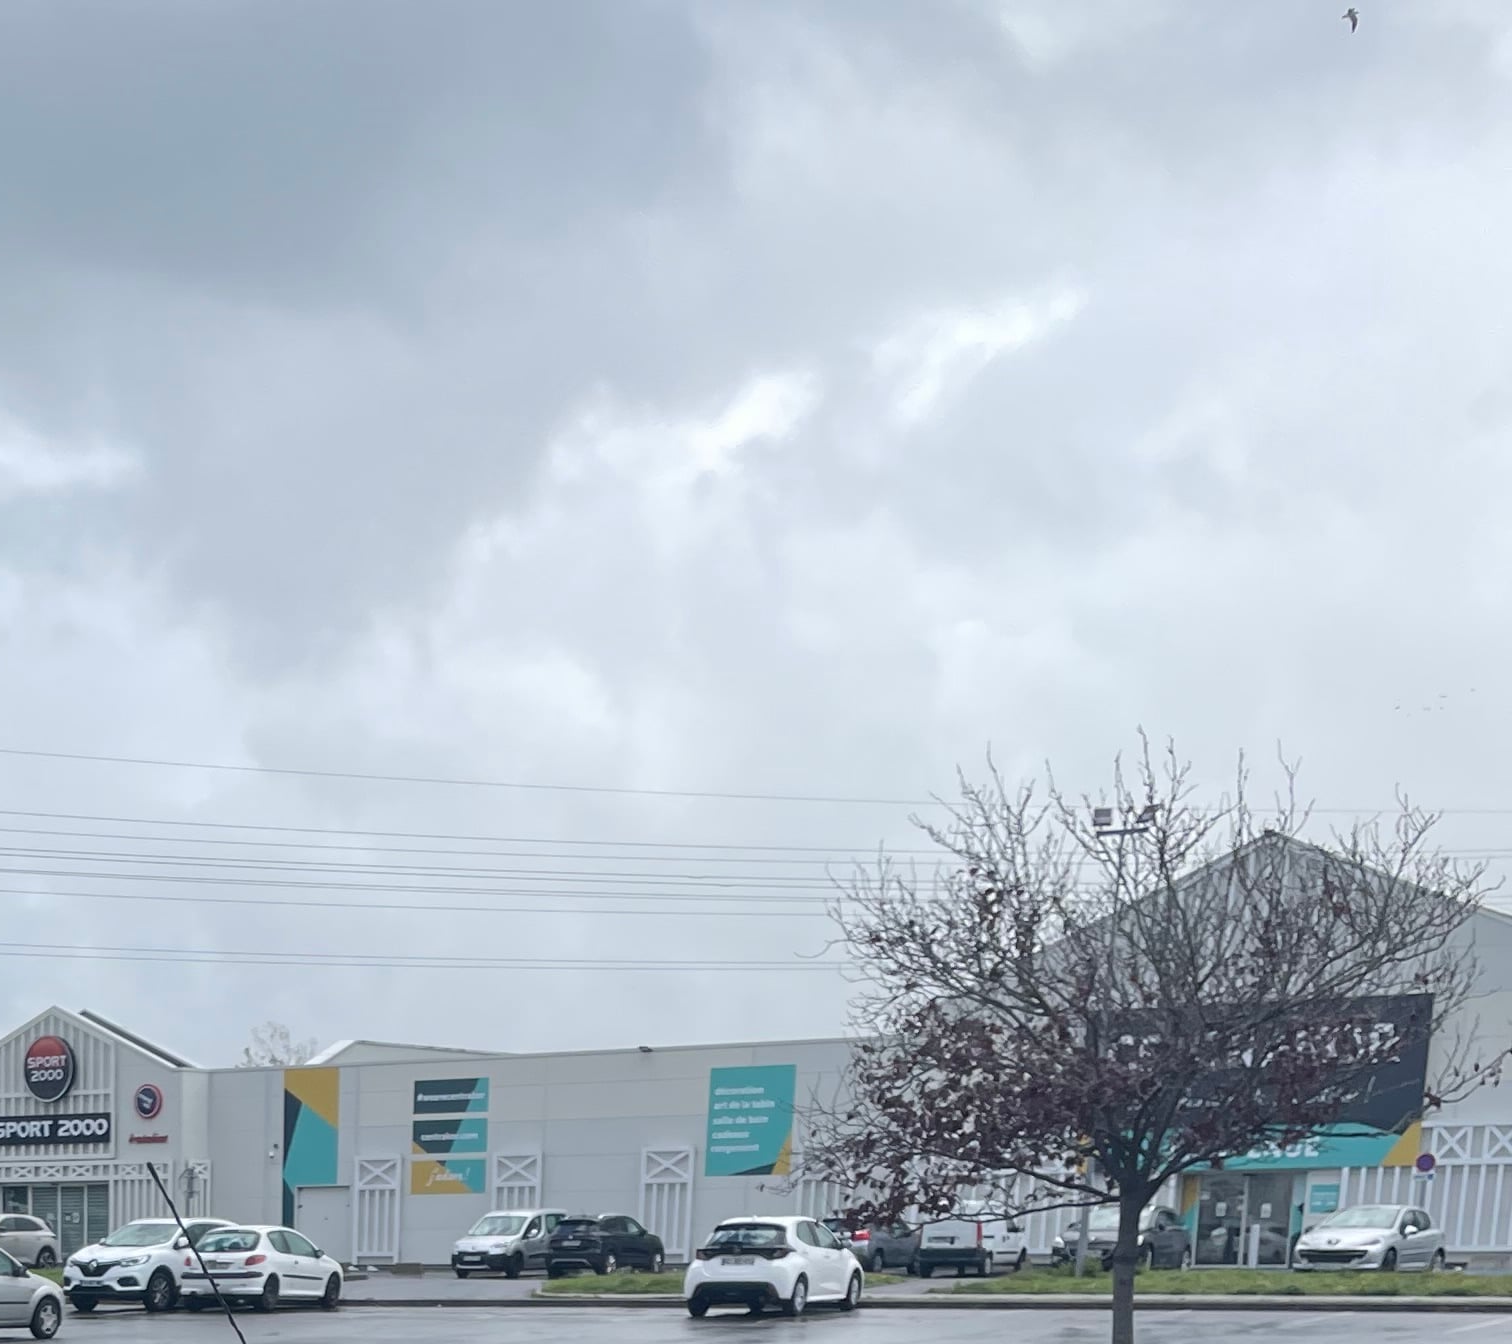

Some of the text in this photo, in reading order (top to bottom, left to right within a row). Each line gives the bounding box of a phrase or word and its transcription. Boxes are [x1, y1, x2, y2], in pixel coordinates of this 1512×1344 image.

[27, 1055, 67, 1069] SPORT
[31, 1069, 64, 1082] 2000
[57, 1118, 108, 1136] 2000
